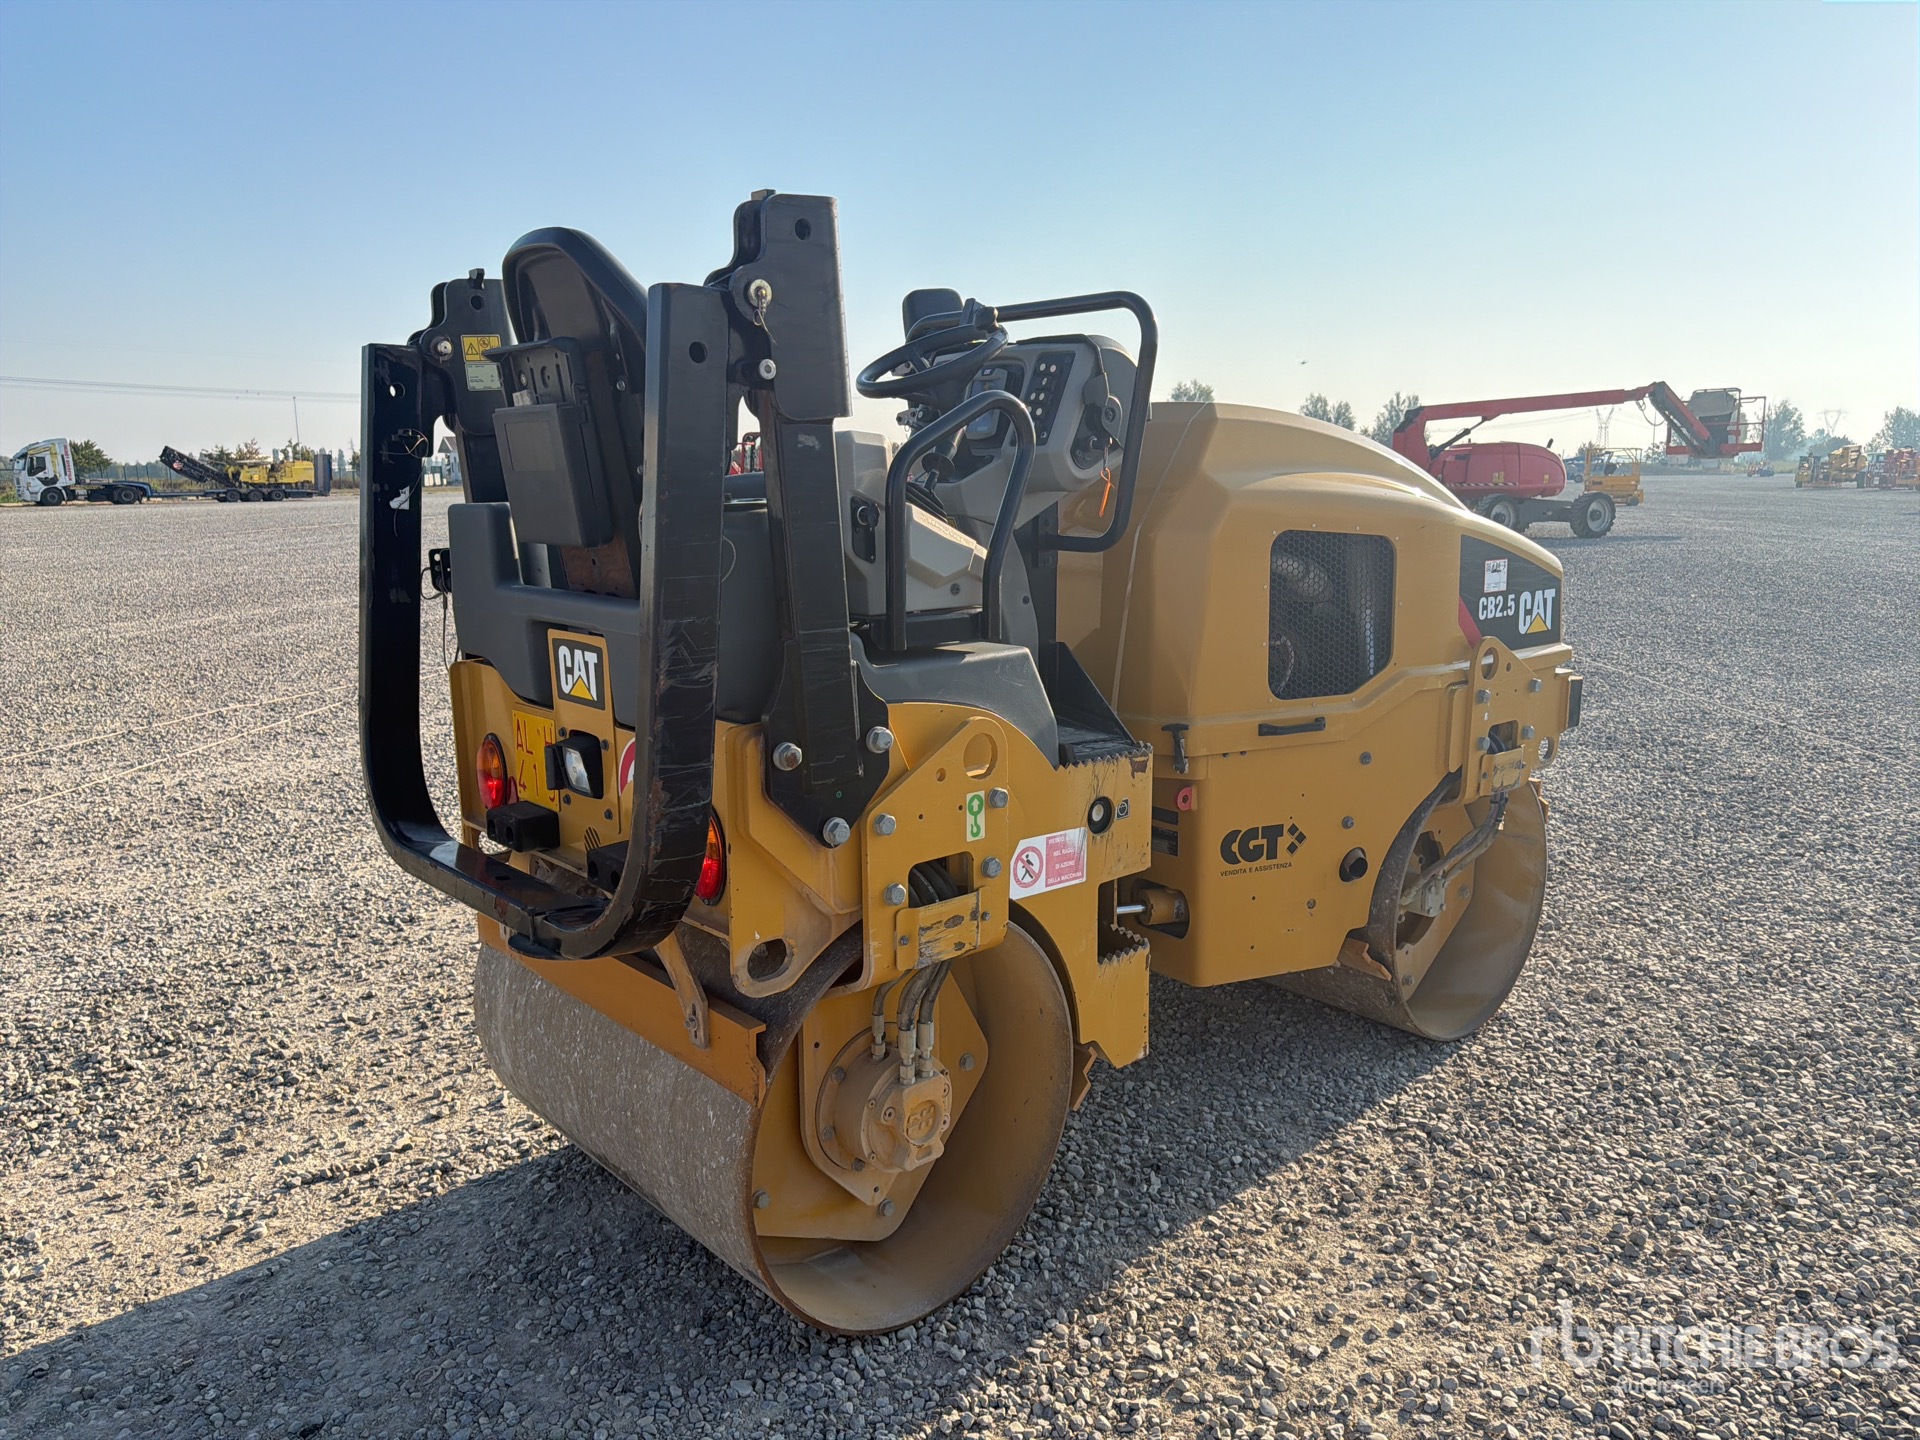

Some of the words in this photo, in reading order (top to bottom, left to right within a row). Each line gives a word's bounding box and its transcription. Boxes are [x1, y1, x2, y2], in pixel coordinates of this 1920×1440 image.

[1478, 594, 1516, 621] CB2.5
[1518, 588, 1556, 635] CAT
[558, 645, 598, 702] CAT
[516, 718, 534, 755] AL
[518, 759, 556, 802] 41
[1220, 823, 1285, 865] CGT
[1220, 868, 1248, 877] VENDITA
[1248, 866, 1254, 874] E
[1254, 862, 1293, 873] ASSISTENZA
